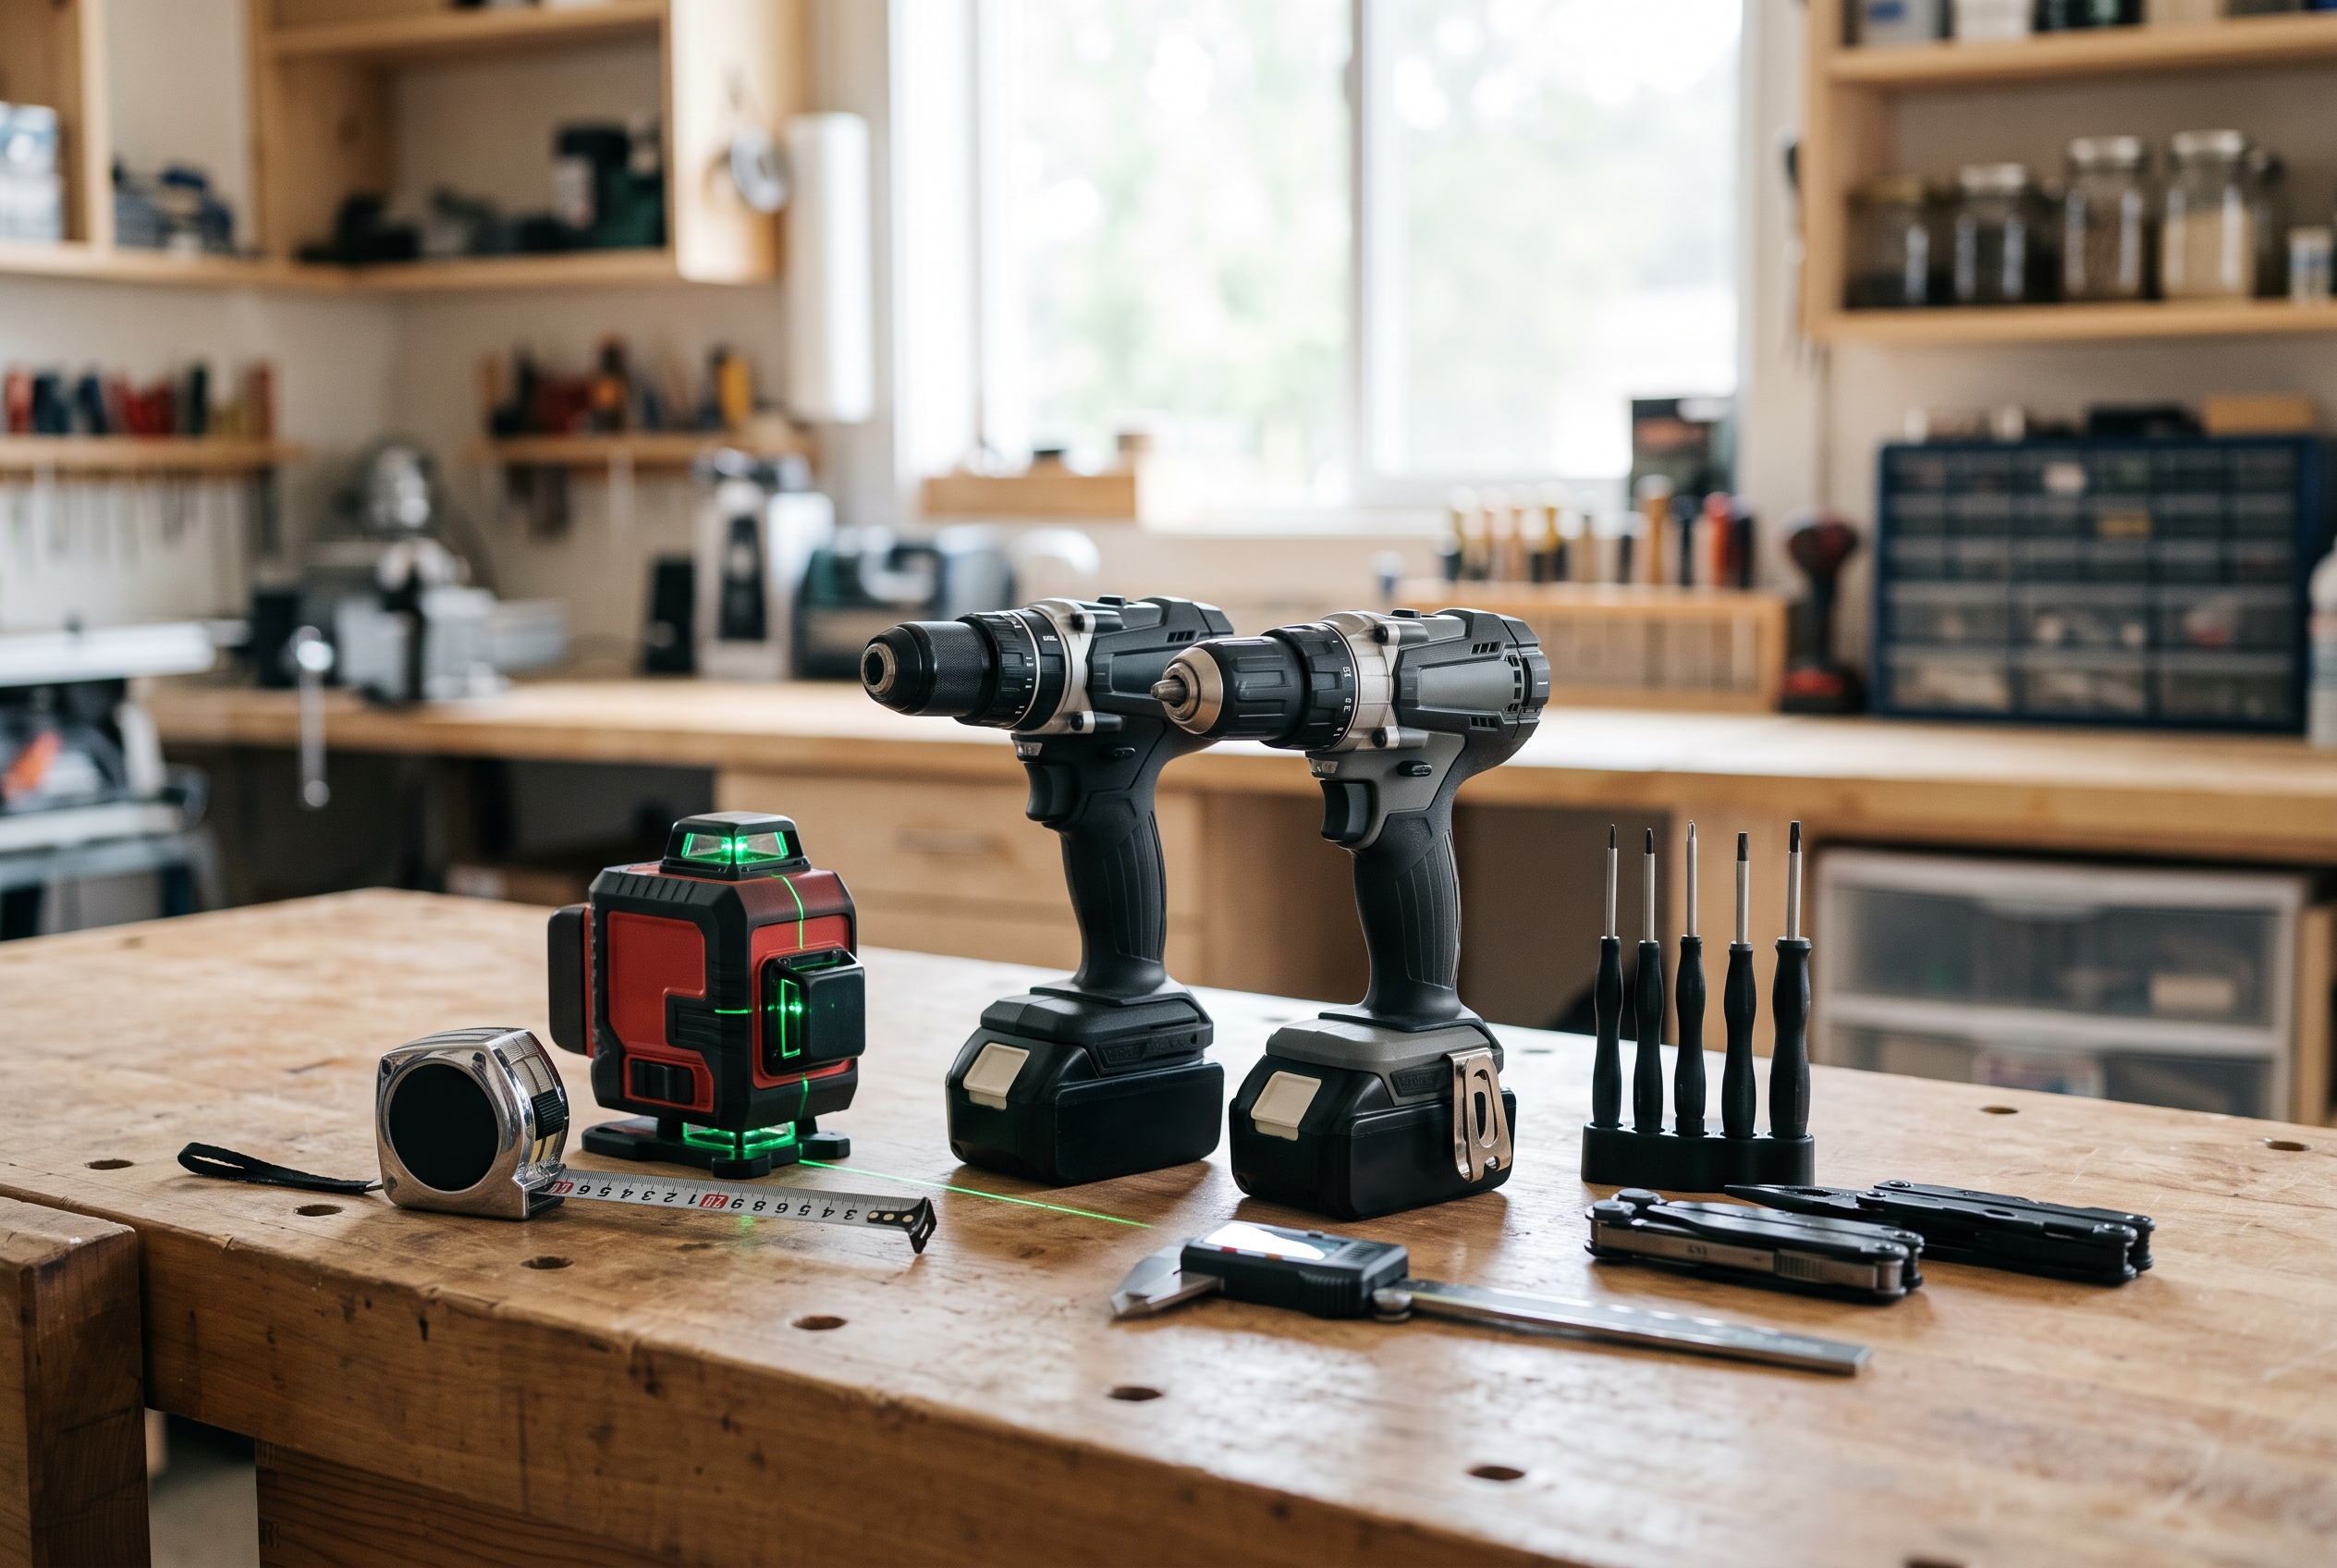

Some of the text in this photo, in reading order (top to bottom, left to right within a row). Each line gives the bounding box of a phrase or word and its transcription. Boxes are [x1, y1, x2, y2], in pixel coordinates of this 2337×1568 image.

[577, 1184, 591, 1194] 6
[597, 1186, 612, 1196] 5
[620, 1188, 633, 1199] 4
[641, 1190, 655, 1200] 3
[663, 1193, 678, 1202] 2
[687, 1194, 697, 1204] 1
[730, 1198, 744, 1208] 9
[752, 1201, 766, 1211] 8
[775, 1203, 789, 1213] 6
[798, 1205, 812, 1216] 5
[821, 1207, 836, 1218] 4
[843, 1209, 858, 1219] 3
